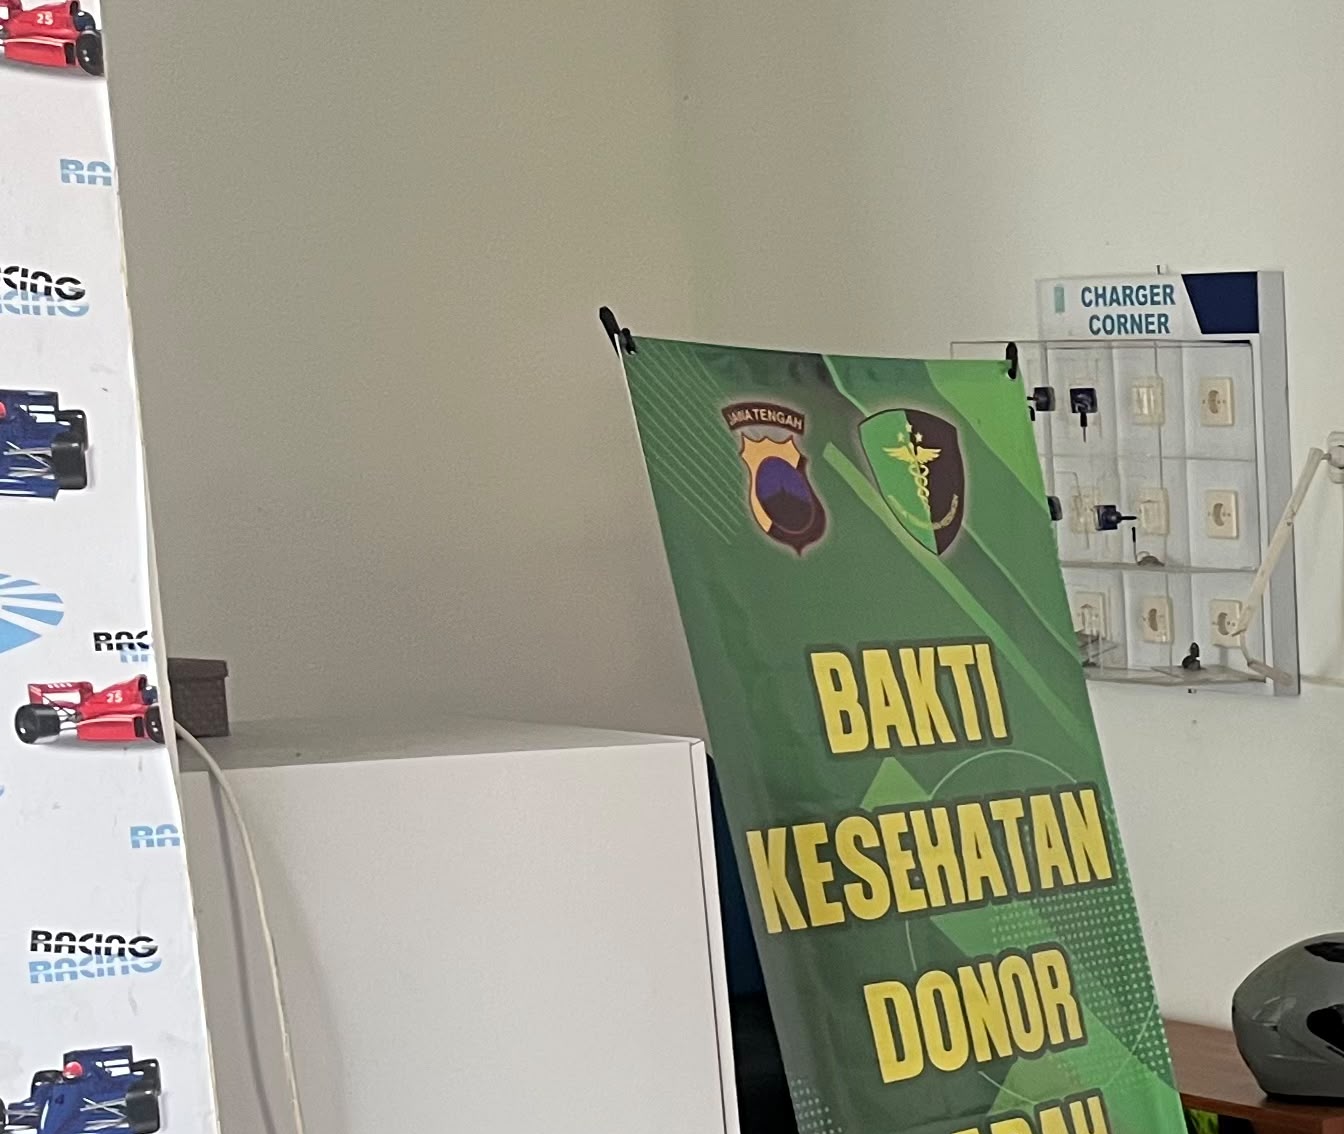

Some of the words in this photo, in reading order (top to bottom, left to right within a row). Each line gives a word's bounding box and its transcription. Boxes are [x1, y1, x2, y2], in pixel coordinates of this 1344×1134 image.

[37, 11, 54, 25] 25
[0, 265, 86, 301] CING
[1080, 283, 1177, 308] CHARGER
[1088, 312, 1171, 336] CORNER
[810, 642, 1009, 755] BAKTI
[745, 788, 1113, 934] KESEHATAN
[30, 929, 159, 958] RACING
[863, 948, 1084, 1084] DONOR
